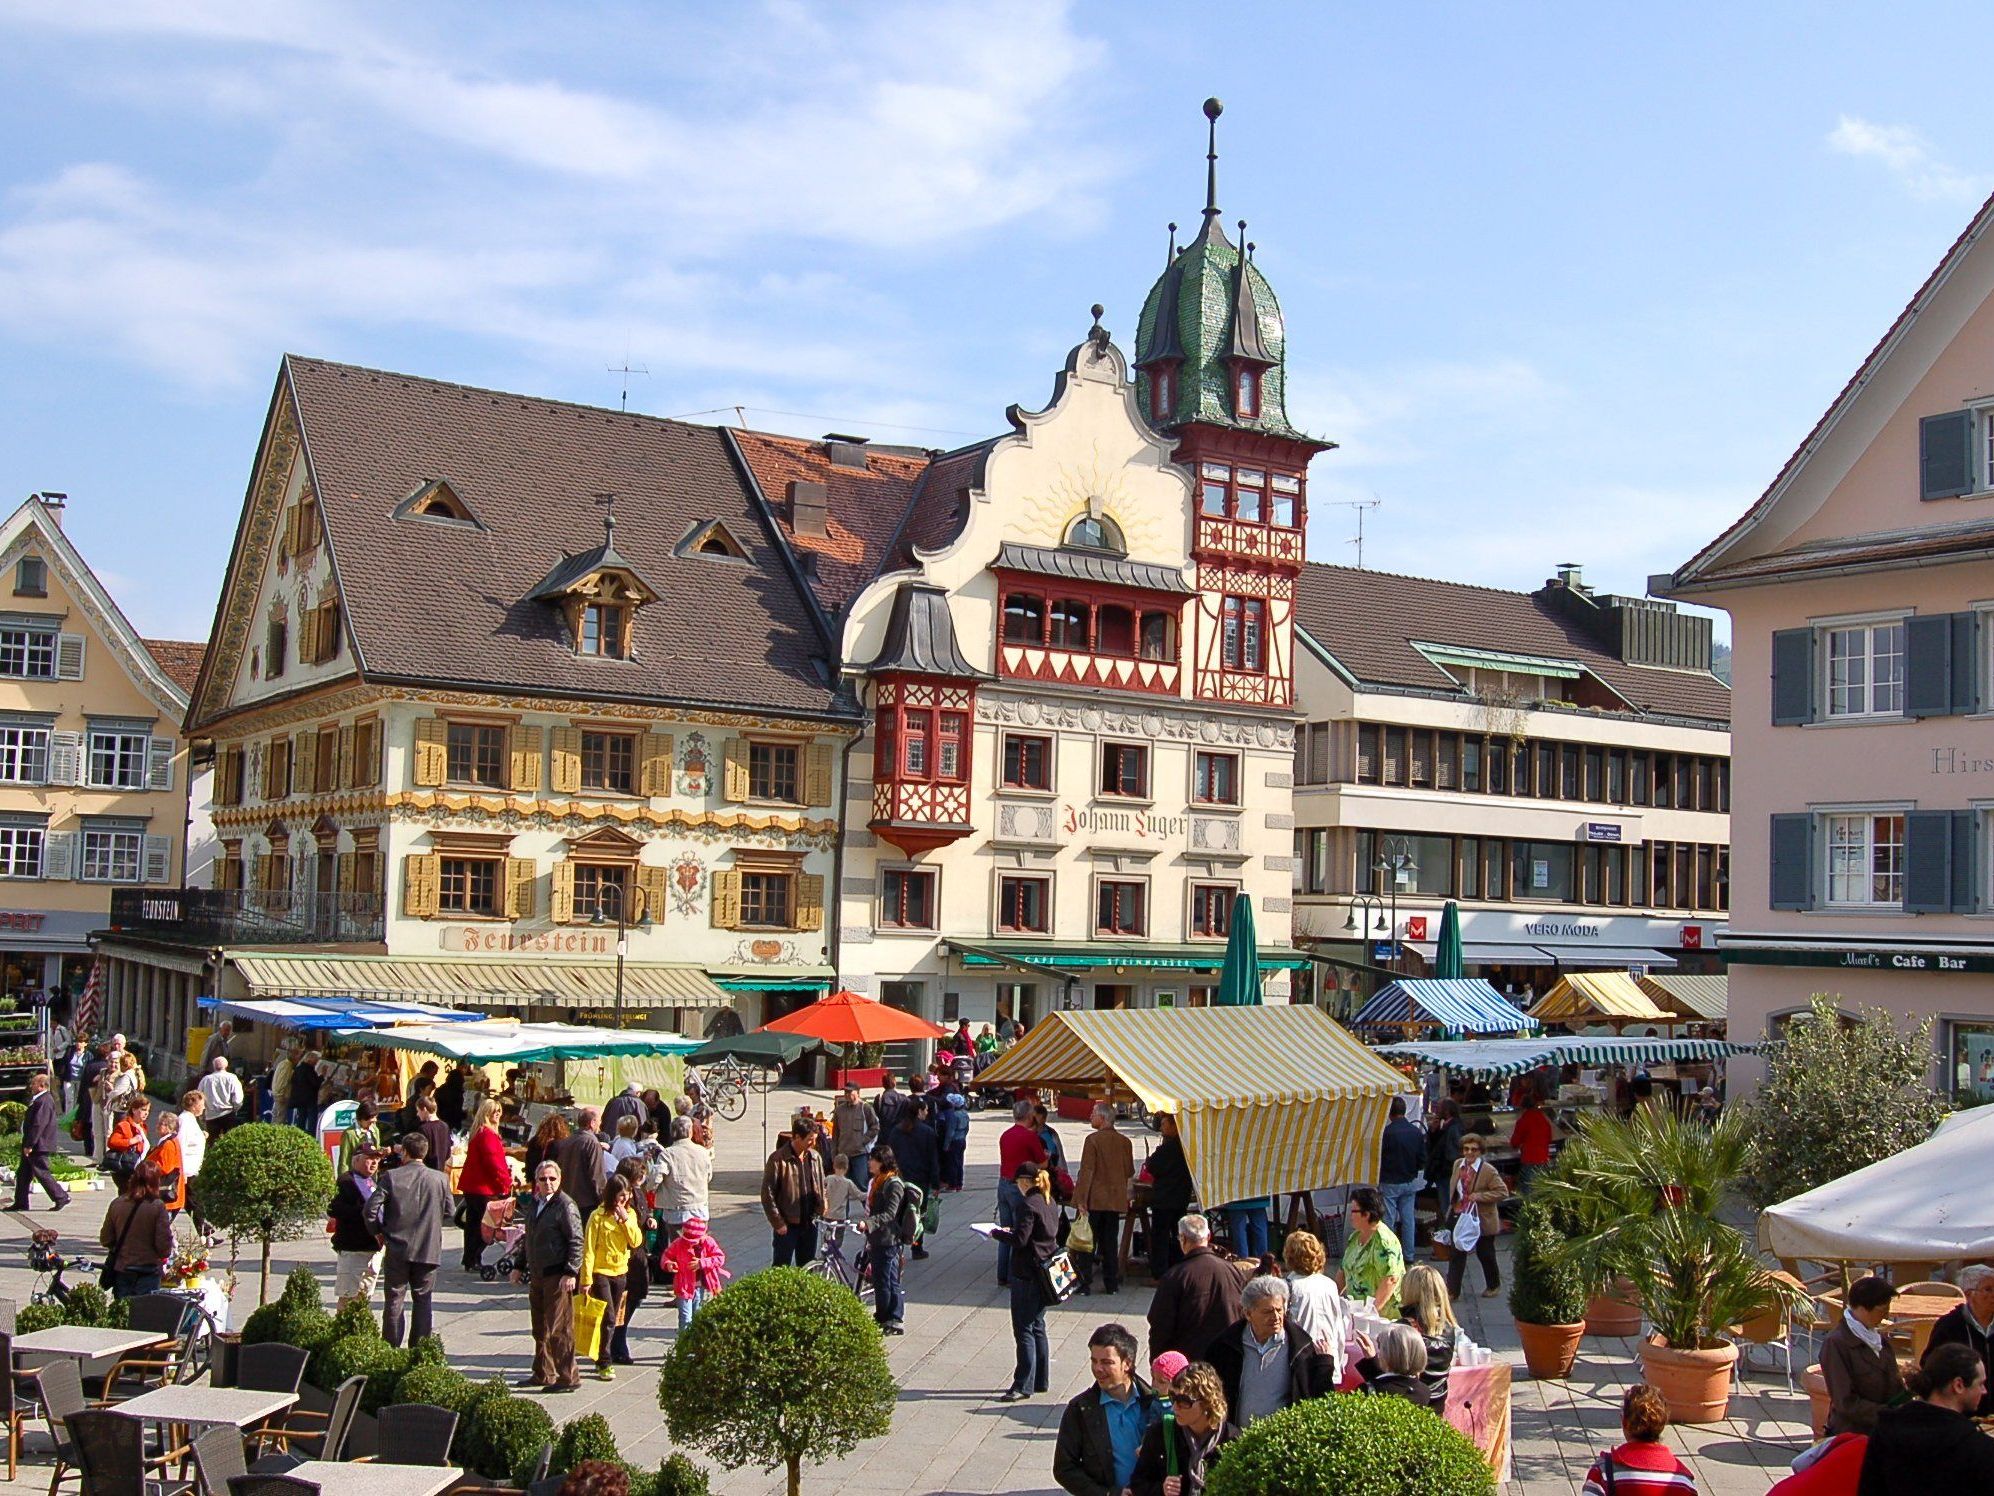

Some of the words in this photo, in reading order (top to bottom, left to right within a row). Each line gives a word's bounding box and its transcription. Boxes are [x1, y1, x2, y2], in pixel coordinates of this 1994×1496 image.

[1063, 804, 1130, 835] Johann
[1136, 808, 1187, 840] Luger
[142, 900, 179, 920] FEURSTEIN
[1525, 923, 1559, 936] VERO
[1562, 923, 1599, 937] MODA
[463, 927, 608, 953] Feurstein
[1107, 958, 1190, 967] STEINHAUSER
[1892, 955, 1926, 968] Cafe
[1938, 956, 1967, 969] Bar
